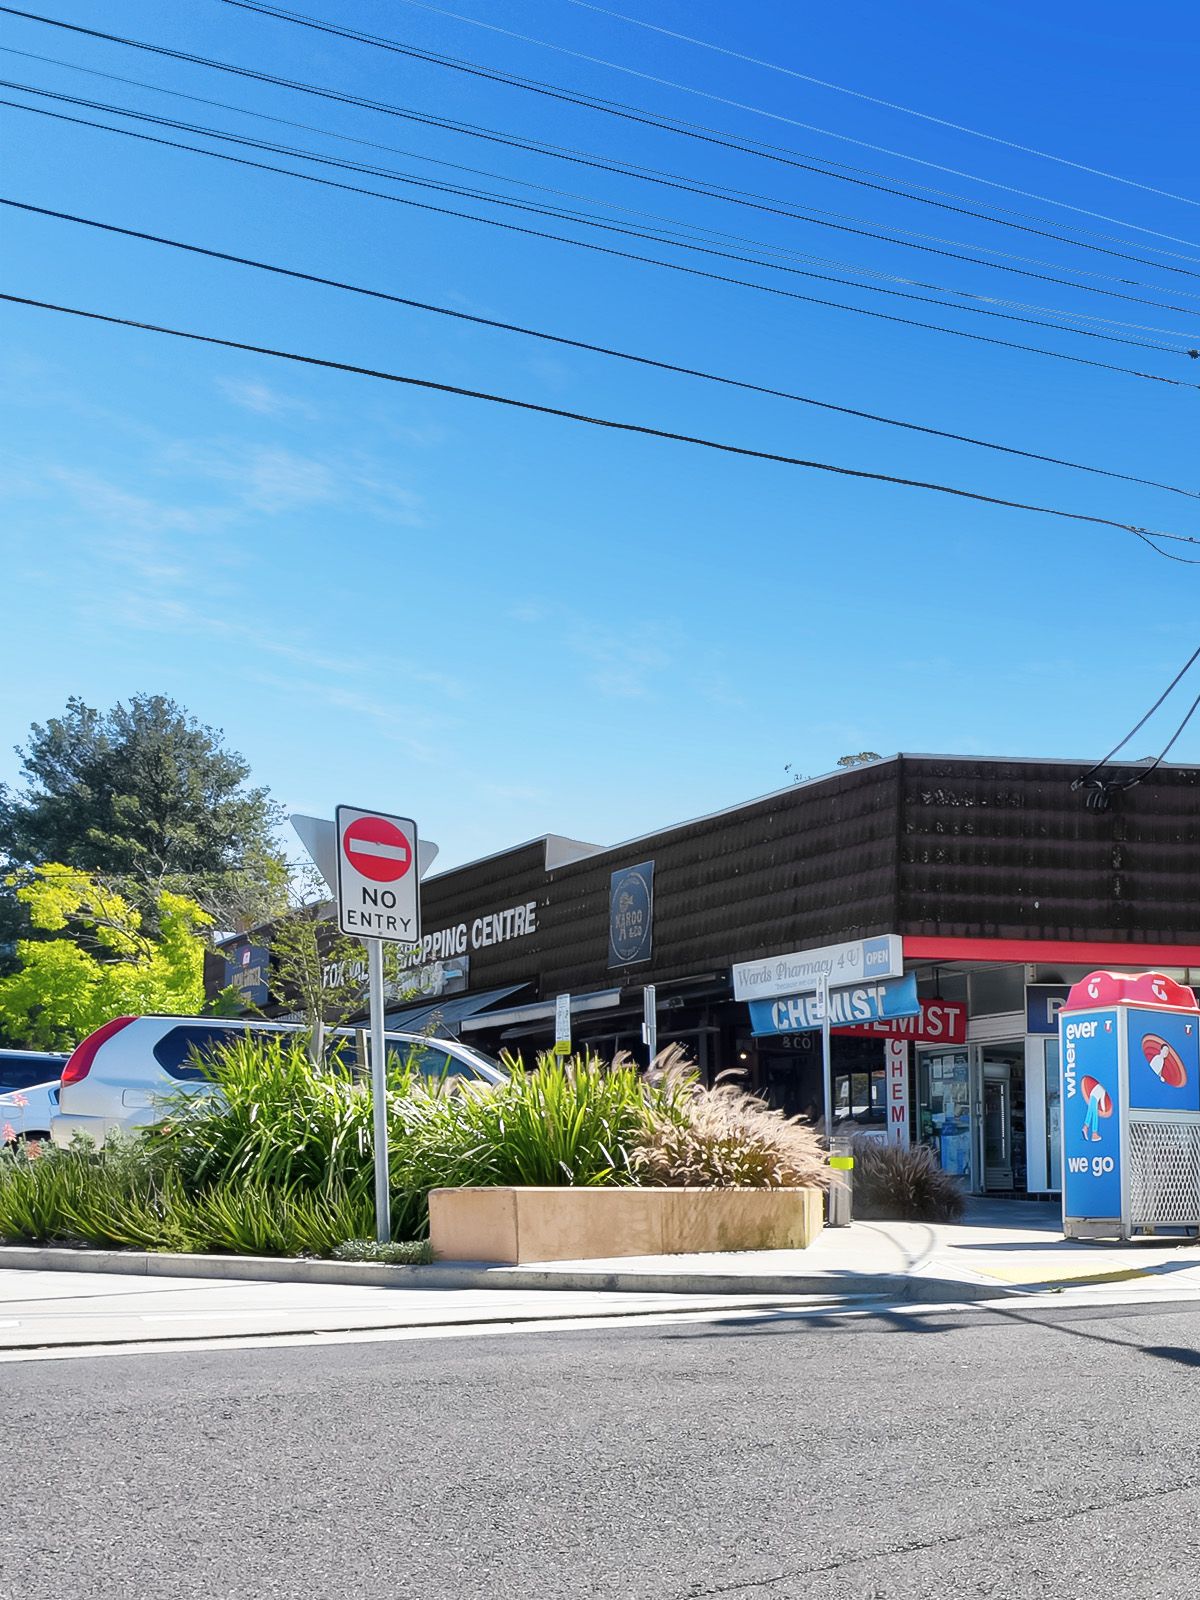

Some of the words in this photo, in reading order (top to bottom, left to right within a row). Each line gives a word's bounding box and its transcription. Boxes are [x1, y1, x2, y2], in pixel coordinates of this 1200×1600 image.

[362, 886, 397, 909] NO
[347, 909, 412, 933] ENTRY
[323, 960, 346, 989] FOX
[471, 902, 537, 949] CENTRE
[866, 949, 889, 966] OPEN
[738, 965, 772, 987] Wards
[775, 957, 833, 981] Pharmacy
[771, 986, 886, 1029] CHEMIST
[891, 1039, 905, 1144] CHEMI
[1068, 1157, 1088, 1174] we
[1092, 1156, 1114, 1176] go
